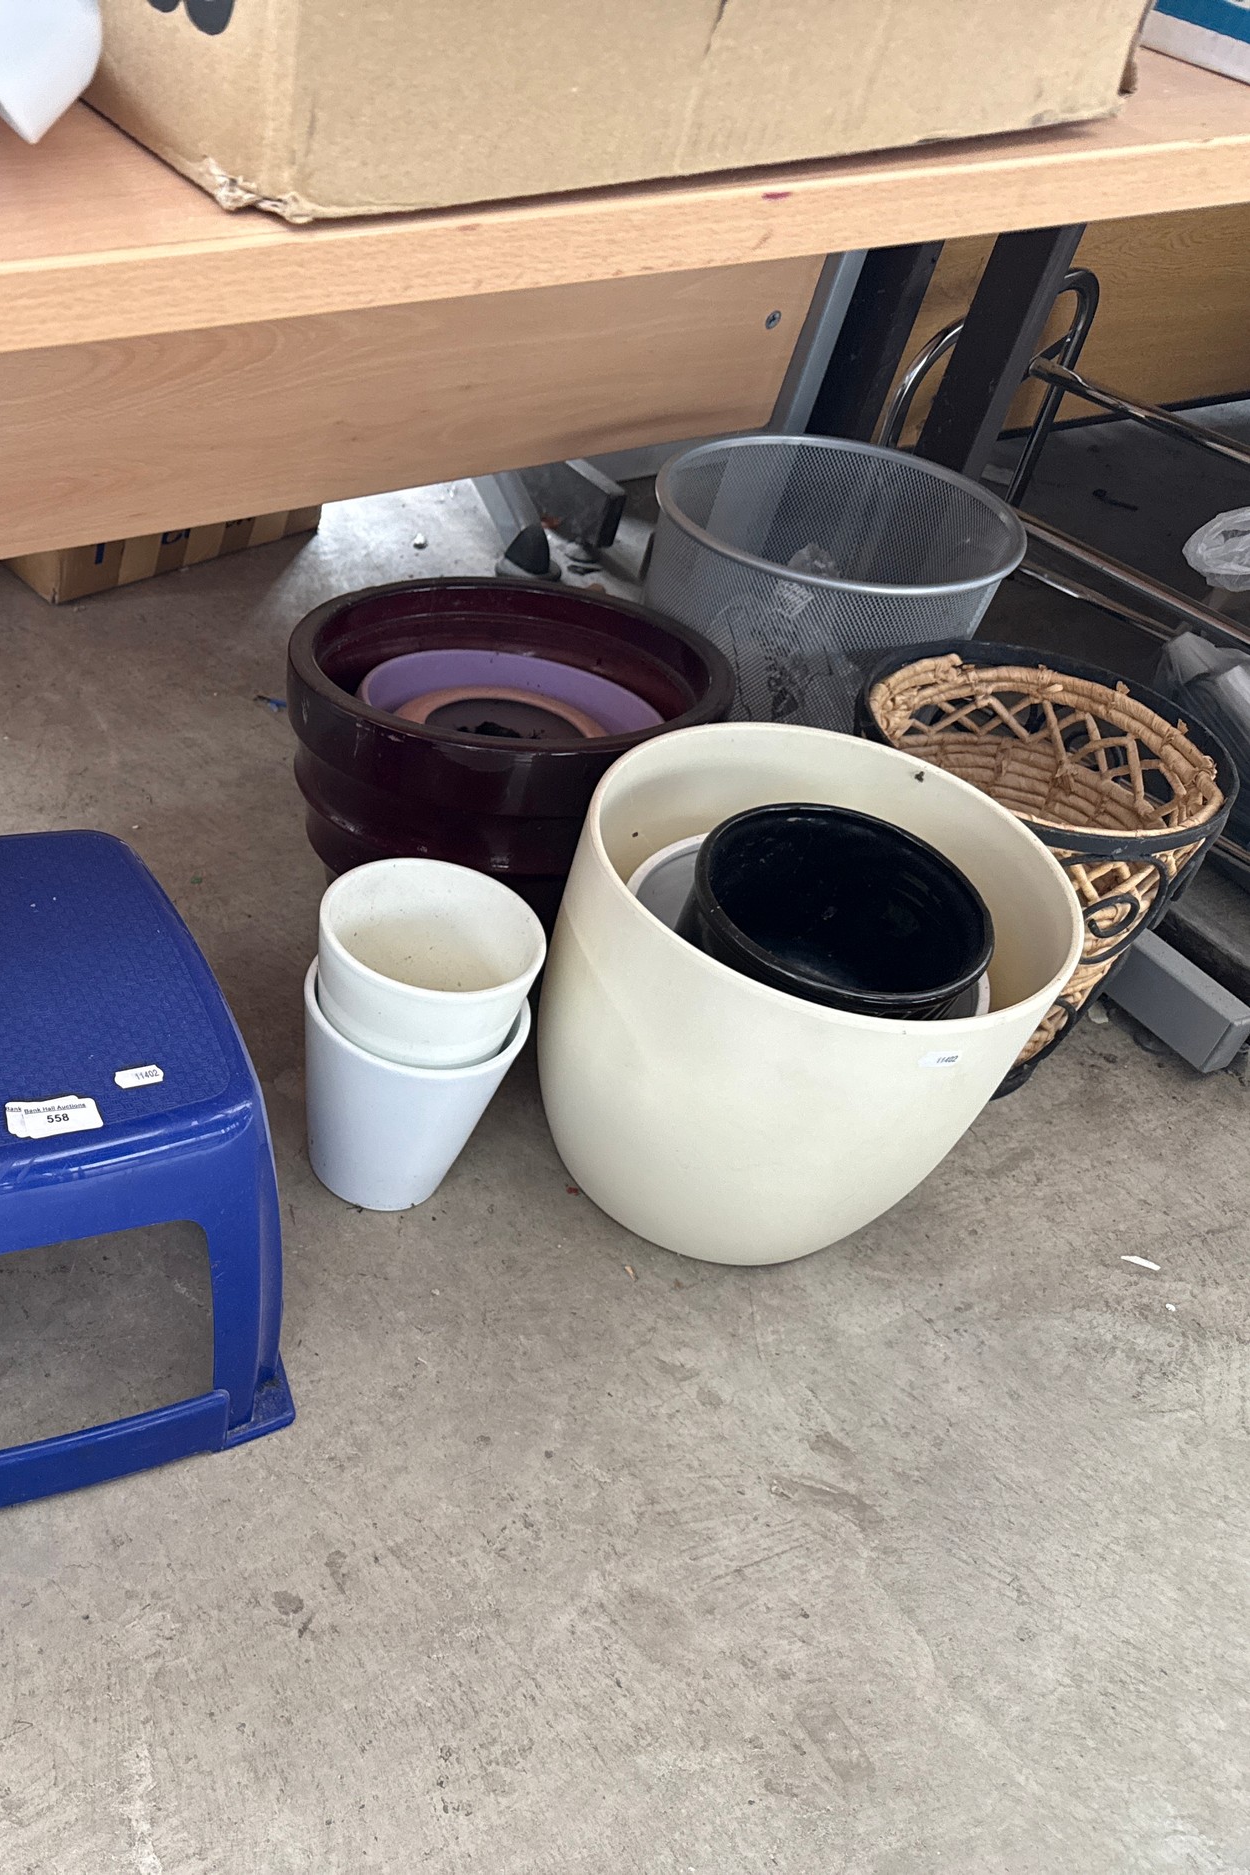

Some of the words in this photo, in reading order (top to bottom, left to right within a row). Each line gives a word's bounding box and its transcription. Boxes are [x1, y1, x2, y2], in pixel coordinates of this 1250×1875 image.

[134, 1069, 160, 1080] 11402
[42, 1104, 56, 1112] Hall
[57, 1102, 86, 1110] Auctions
[46, 1113, 70, 1124] 558
